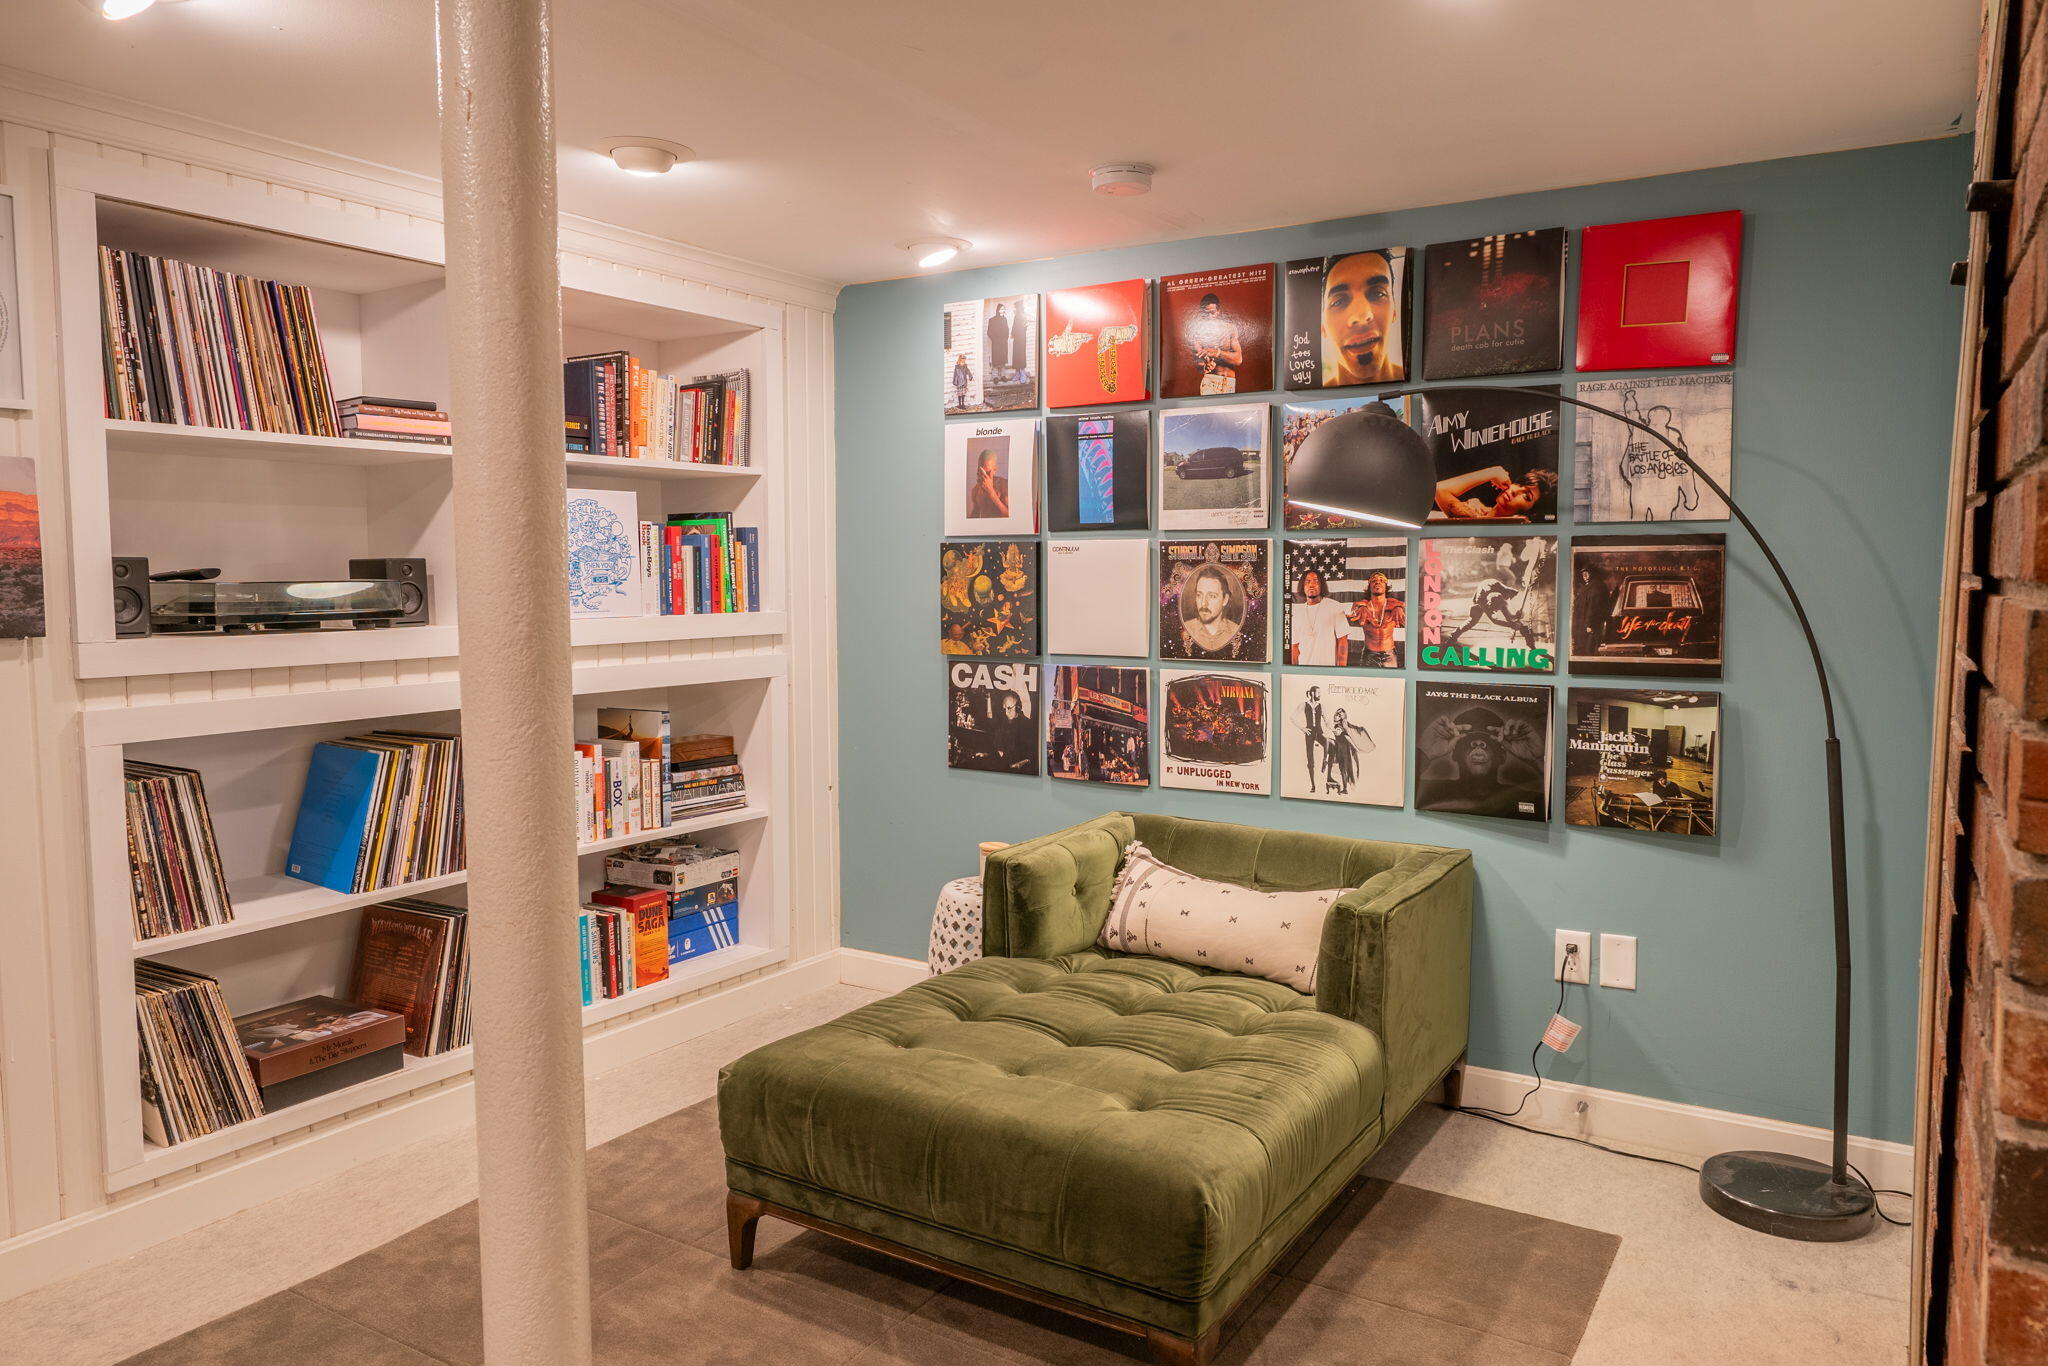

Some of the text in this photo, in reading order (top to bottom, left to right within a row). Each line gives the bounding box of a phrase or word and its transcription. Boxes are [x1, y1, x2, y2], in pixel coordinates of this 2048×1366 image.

[1249, 269, 1267, 277] HITS
[1451, 319, 1525, 343] PLANS
[1293, 331, 1310, 349] god
[1451, 338, 1526, 352] death cab for cutie
[1292, 371, 1312, 385] ugly
[1579, 374, 1732, 392] RAGE AGAINST THE MACHINE
[1427, 410, 1469, 438] AMY
[976, 427, 1003, 436] blonde
[1451, 410, 1553, 453] WINEHOUSE
[1628, 441, 1649, 452] THE
[1628, 449, 1674, 463] BATTLE OF
[1629, 464, 1646, 476] LOS
[1464, 545, 1495, 554] Clash
[1423, 540, 1443, 645] LONDON
[1421, 646, 1550, 669] CALLING
[951, 662, 1038, 692] CASH
[1220, 685, 1254, 699] NIRVANA
[1471, 693, 1502, 701] BLACK
[1569, 739, 1650, 755] Mannequin
[1600, 751, 1620, 760] The
[1600, 759, 1627, 768] Glass
[1177, 766, 1232, 779] UNPLUGGED
[1600, 766, 1654, 778] Passenger
[1241, 782, 1260, 790] YORK
[613, 780, 622, 808] BOX
[639, 905, 663, 920] DUNE
[638, 916, 665, 933] SAGA
